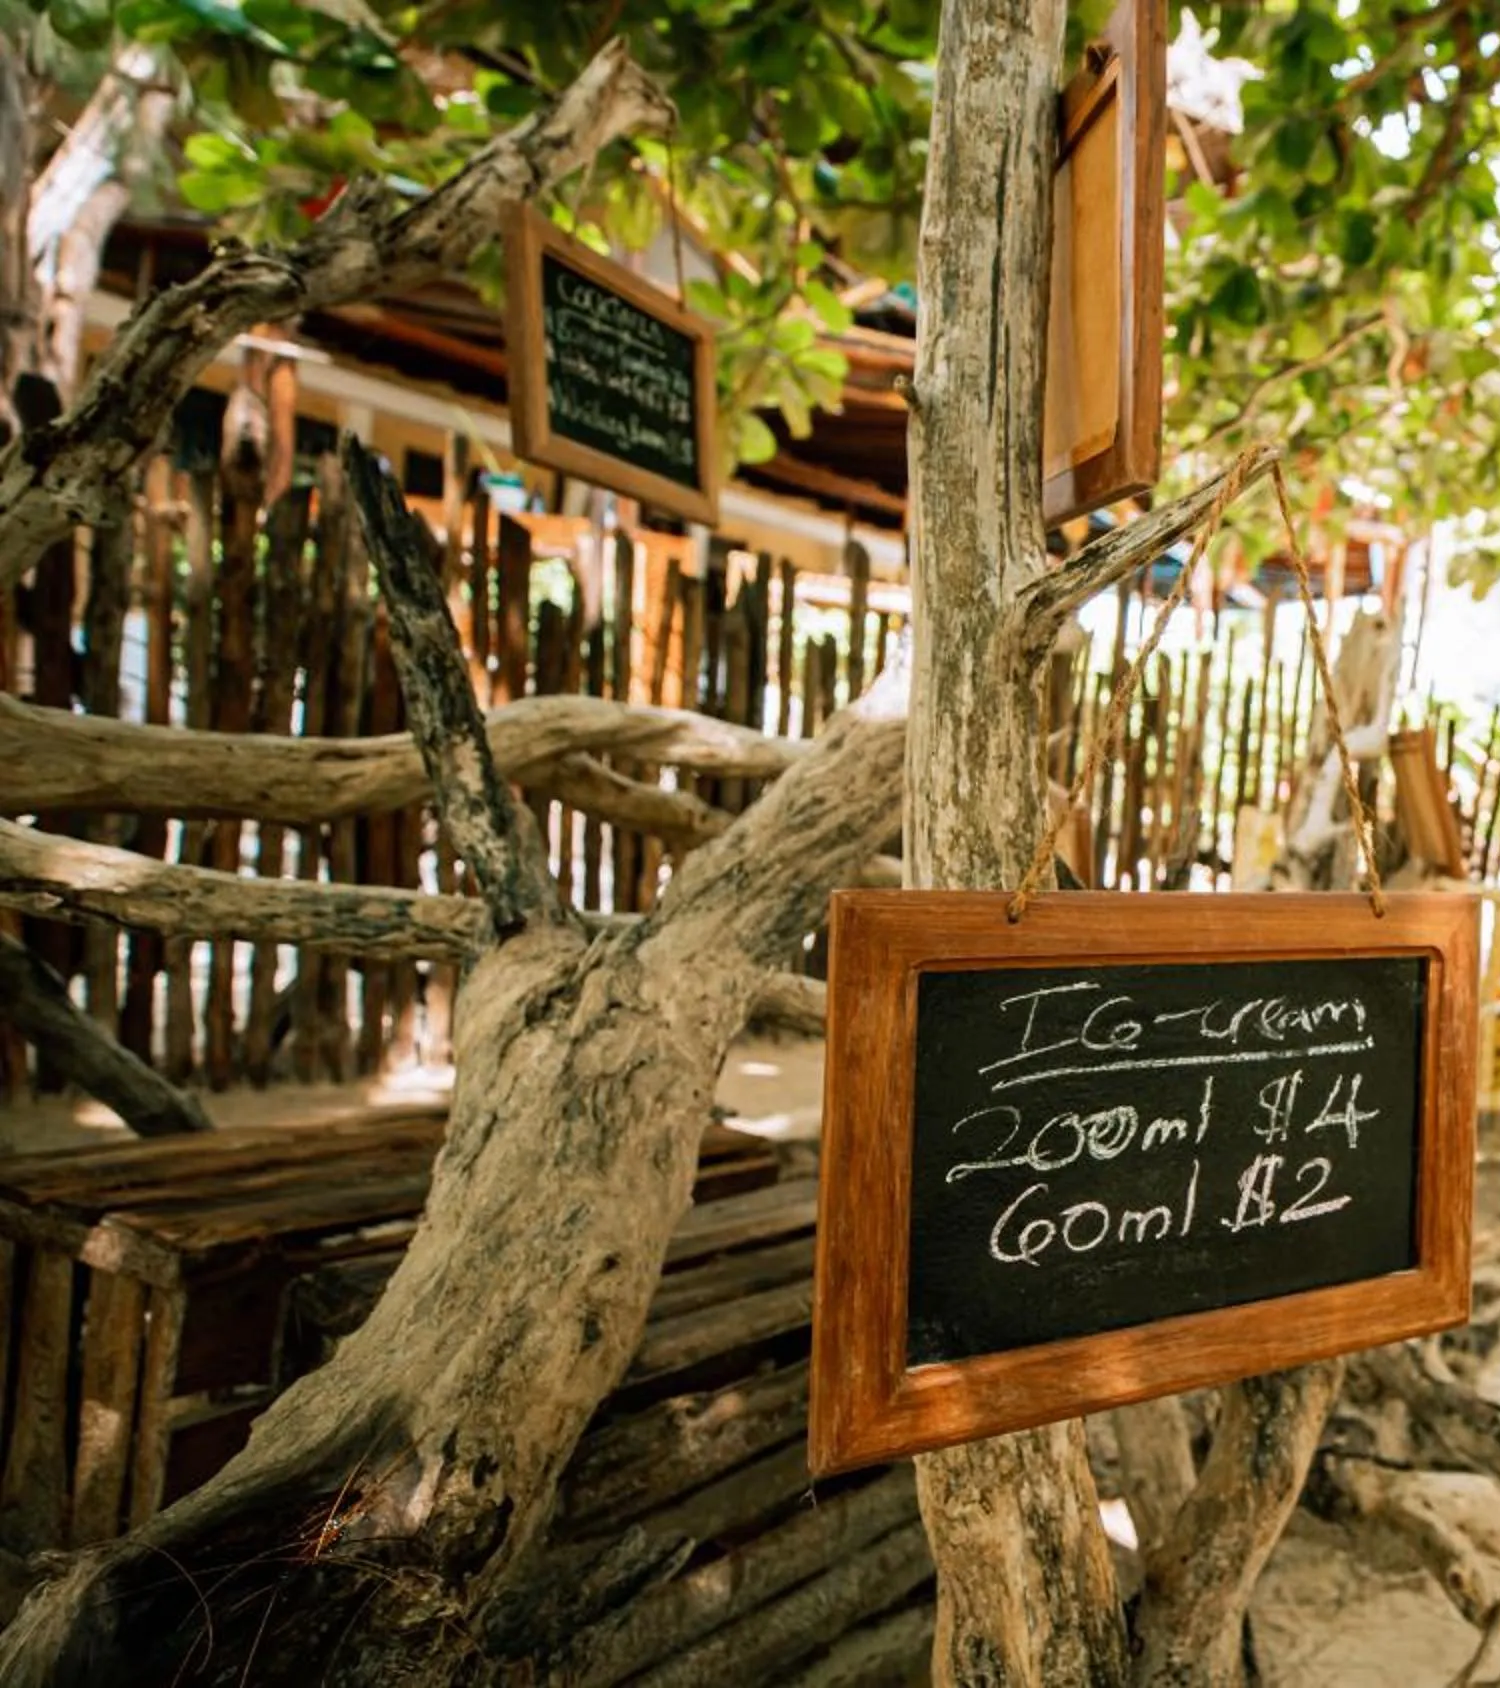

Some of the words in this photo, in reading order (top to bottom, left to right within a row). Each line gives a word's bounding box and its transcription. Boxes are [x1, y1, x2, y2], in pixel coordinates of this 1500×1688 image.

[945, 1075, 1213, 1182] 200ml
[1253, 1069, 1380, 1148] $4
[988, 1159, 1199, 1267] 60ml
[1220, 1154, 1352, 1233] $2
